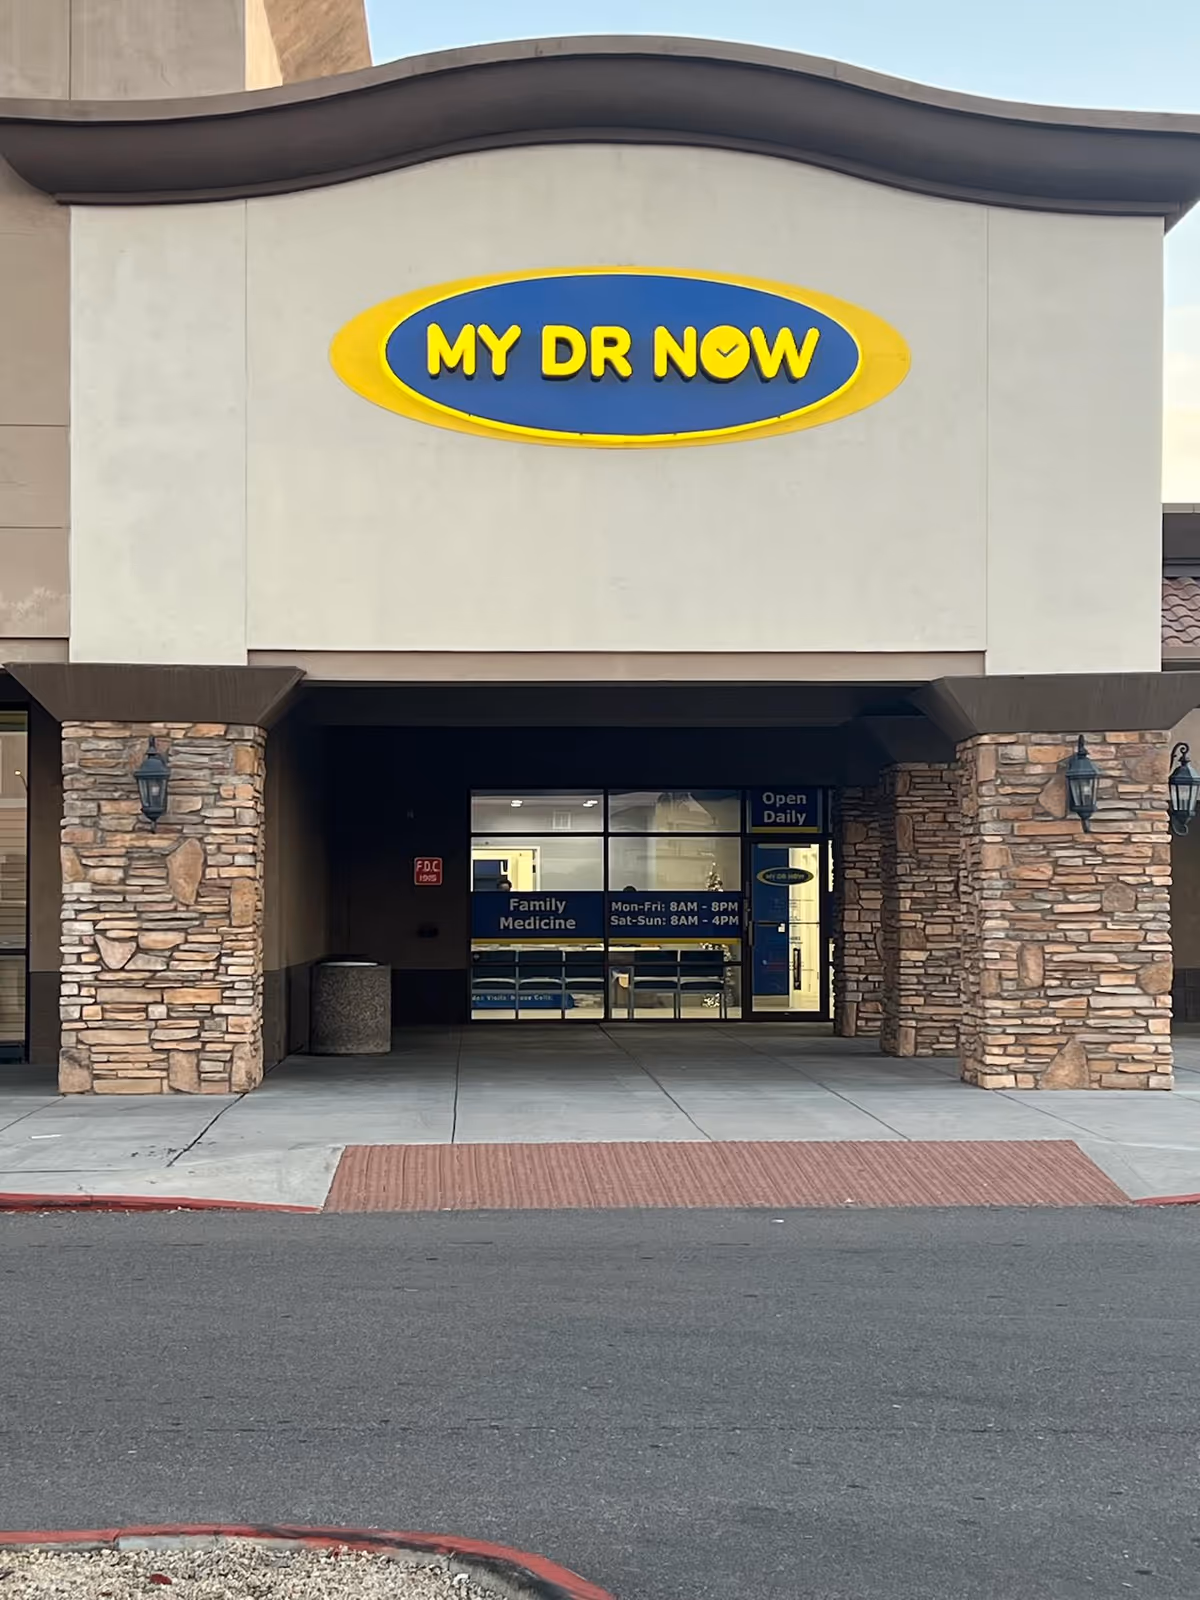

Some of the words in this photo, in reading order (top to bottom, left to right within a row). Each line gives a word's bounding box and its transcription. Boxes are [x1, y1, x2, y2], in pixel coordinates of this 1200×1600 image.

[427, 323, 522, 378] MY
[541, 324, 634, 378] DR
[653, 324, 820, 380] NOW
[762, 792, 807, 807] Open
[763, 810, 807, 825] Daily
[509, 897, 567, 914] Family
[611, 901, 666, 912] Mon-Fri:
[669, 901, 698, 912] 8AM
[711, 901, 738, 912] 8PM
[499, 916, 577, 930] Medicine
[610, 915, 667, 926] Sat-Sun:
[670, 915, 699, 926] 8AM
[711, 915, 740, 926] 4PM
